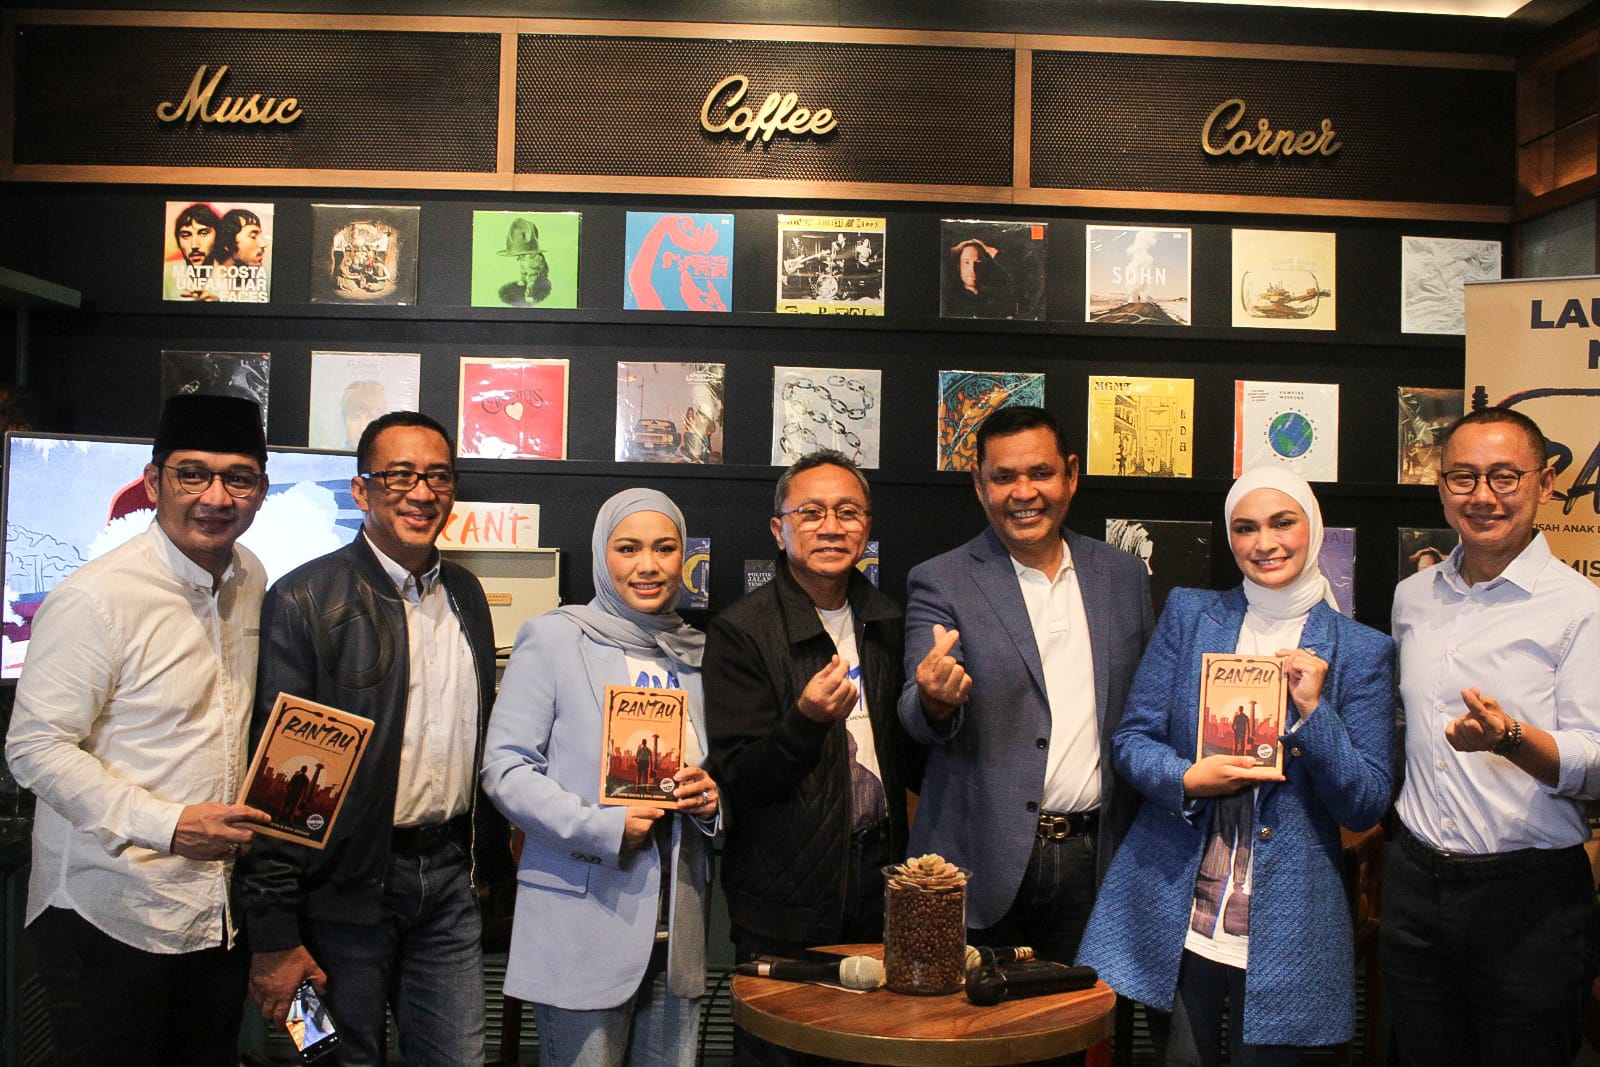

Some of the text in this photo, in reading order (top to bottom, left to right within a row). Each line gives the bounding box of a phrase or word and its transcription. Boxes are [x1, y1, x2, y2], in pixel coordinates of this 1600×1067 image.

[156, 64, 303, 124] Music
[701, 74, 838, 142] Coffee
[1201, 98, 1344, 156] Corner
[172, 265, 268, 279] MATT COSTA
[1112, 266, 1167, 286] SOHN
[175, 278, 268, 292] UNFAMILIAR
[219, 291, 269, 303] FACES
[1094, 381, 1132, 391] MGMT
[1562, 524, 1595, 534] ANAK
[1213, 666, 1275, 686] RANTAU
[616, 698, 677, 718] RANTAU
[280, 714, 356, 752] RANTAU
